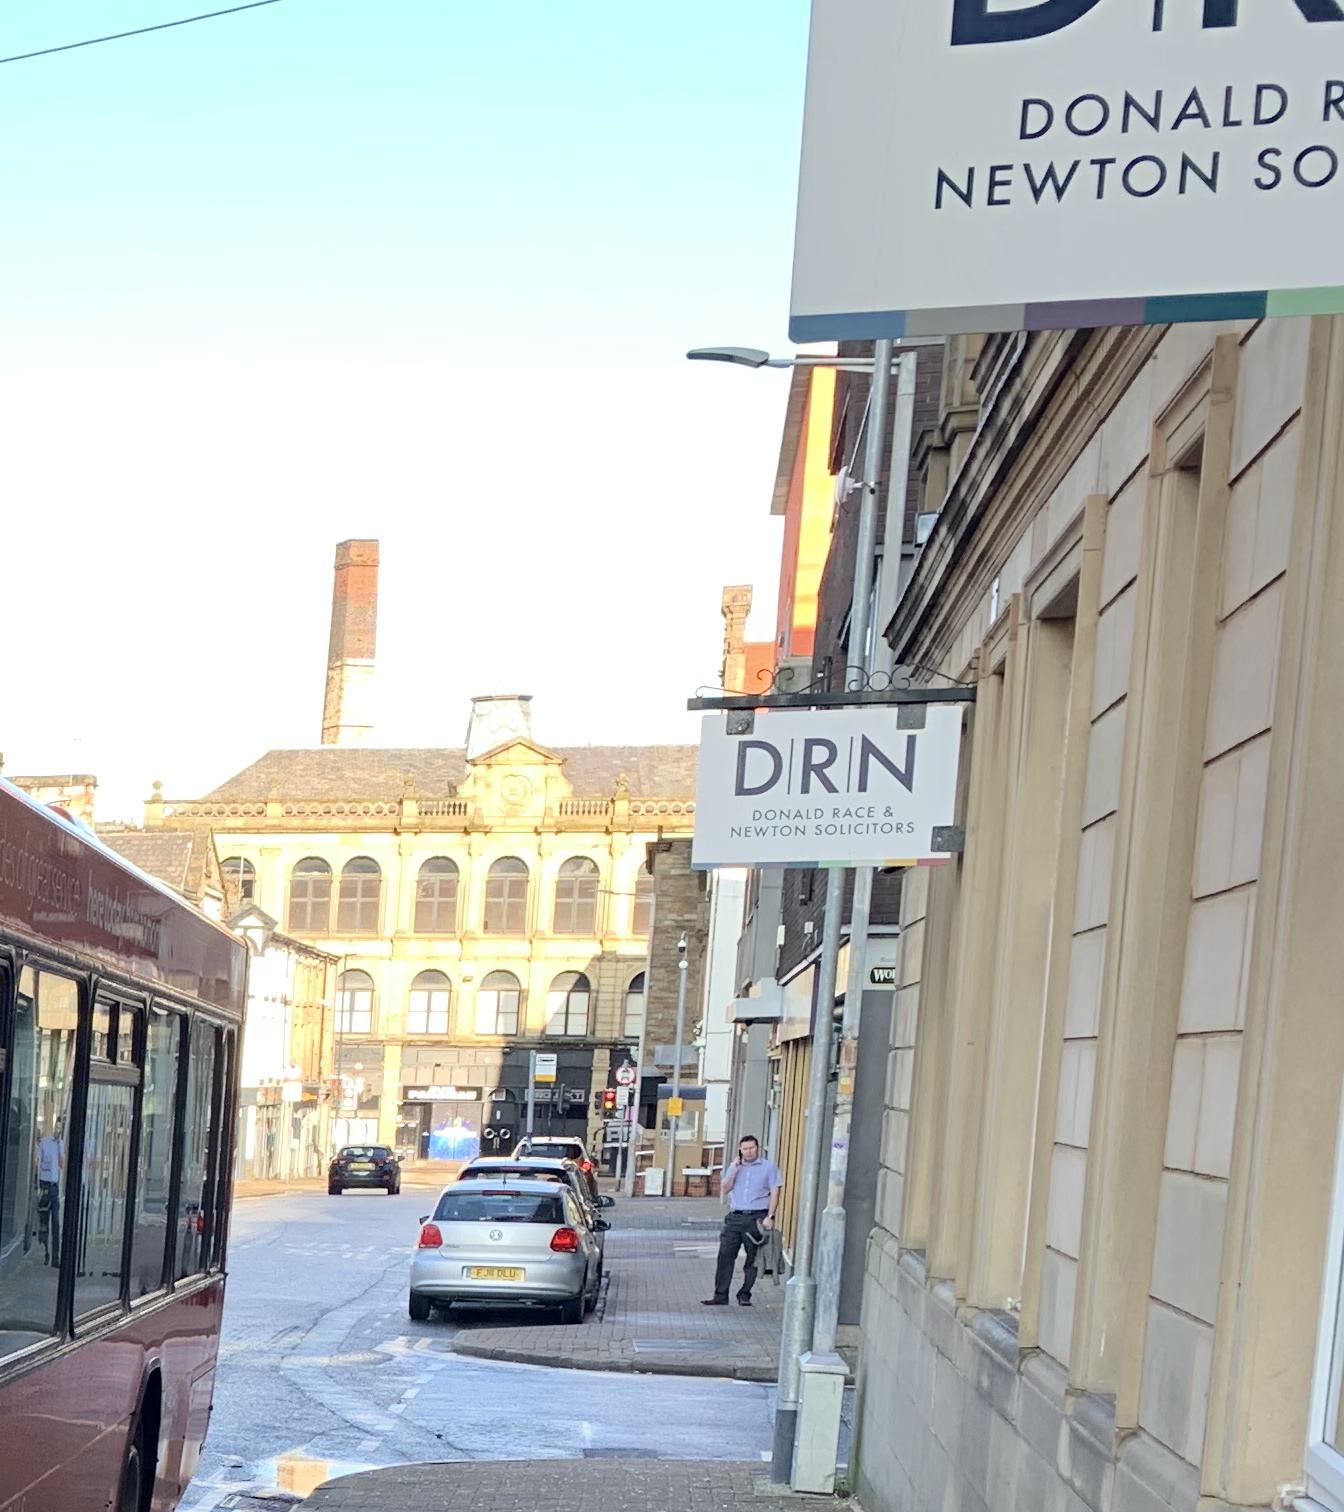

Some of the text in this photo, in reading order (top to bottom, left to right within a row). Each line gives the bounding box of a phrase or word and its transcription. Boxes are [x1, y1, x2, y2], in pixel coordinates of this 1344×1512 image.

[1019, 85, 1288, 140] DONALD
[934, 152, 1219, 211] NEWTON
[752, 805, 894, 821] DONALD RACE &
[730, 821, 915, 838] NEWTON SOLICITORS
[497, 1268, 516, 1279] DLU
